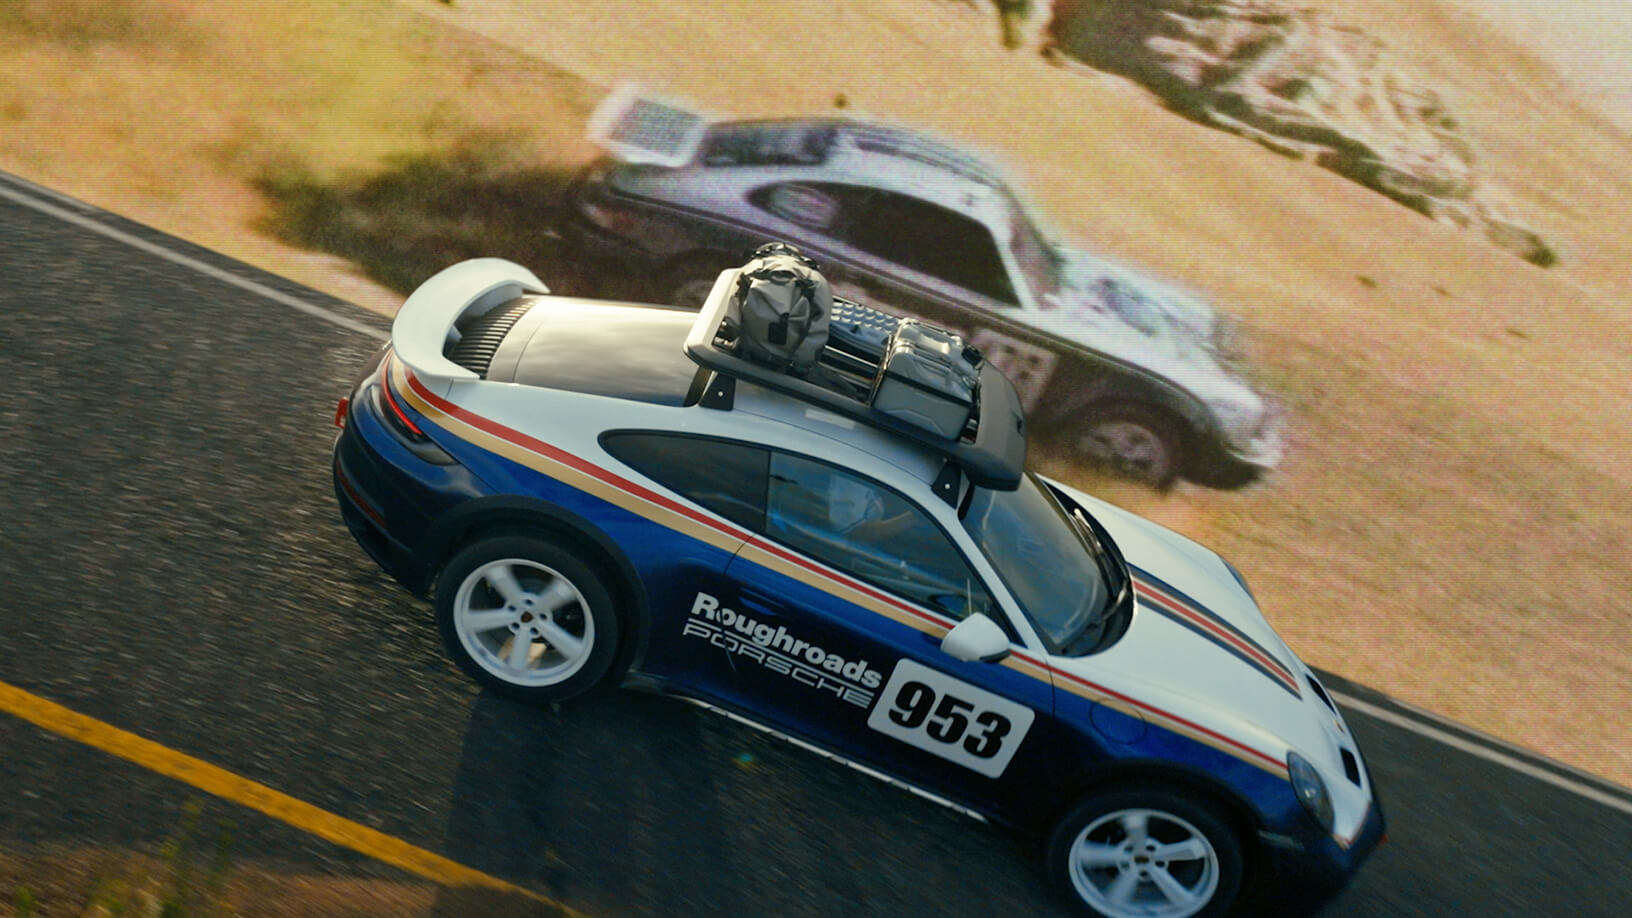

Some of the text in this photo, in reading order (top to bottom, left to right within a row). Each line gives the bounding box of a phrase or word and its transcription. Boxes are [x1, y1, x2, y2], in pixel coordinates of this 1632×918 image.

[683, 623, 875, 709] PORSCHE
[691, 592, 882, 689] Roughroads
[888, 681, 1012, 759] 953
